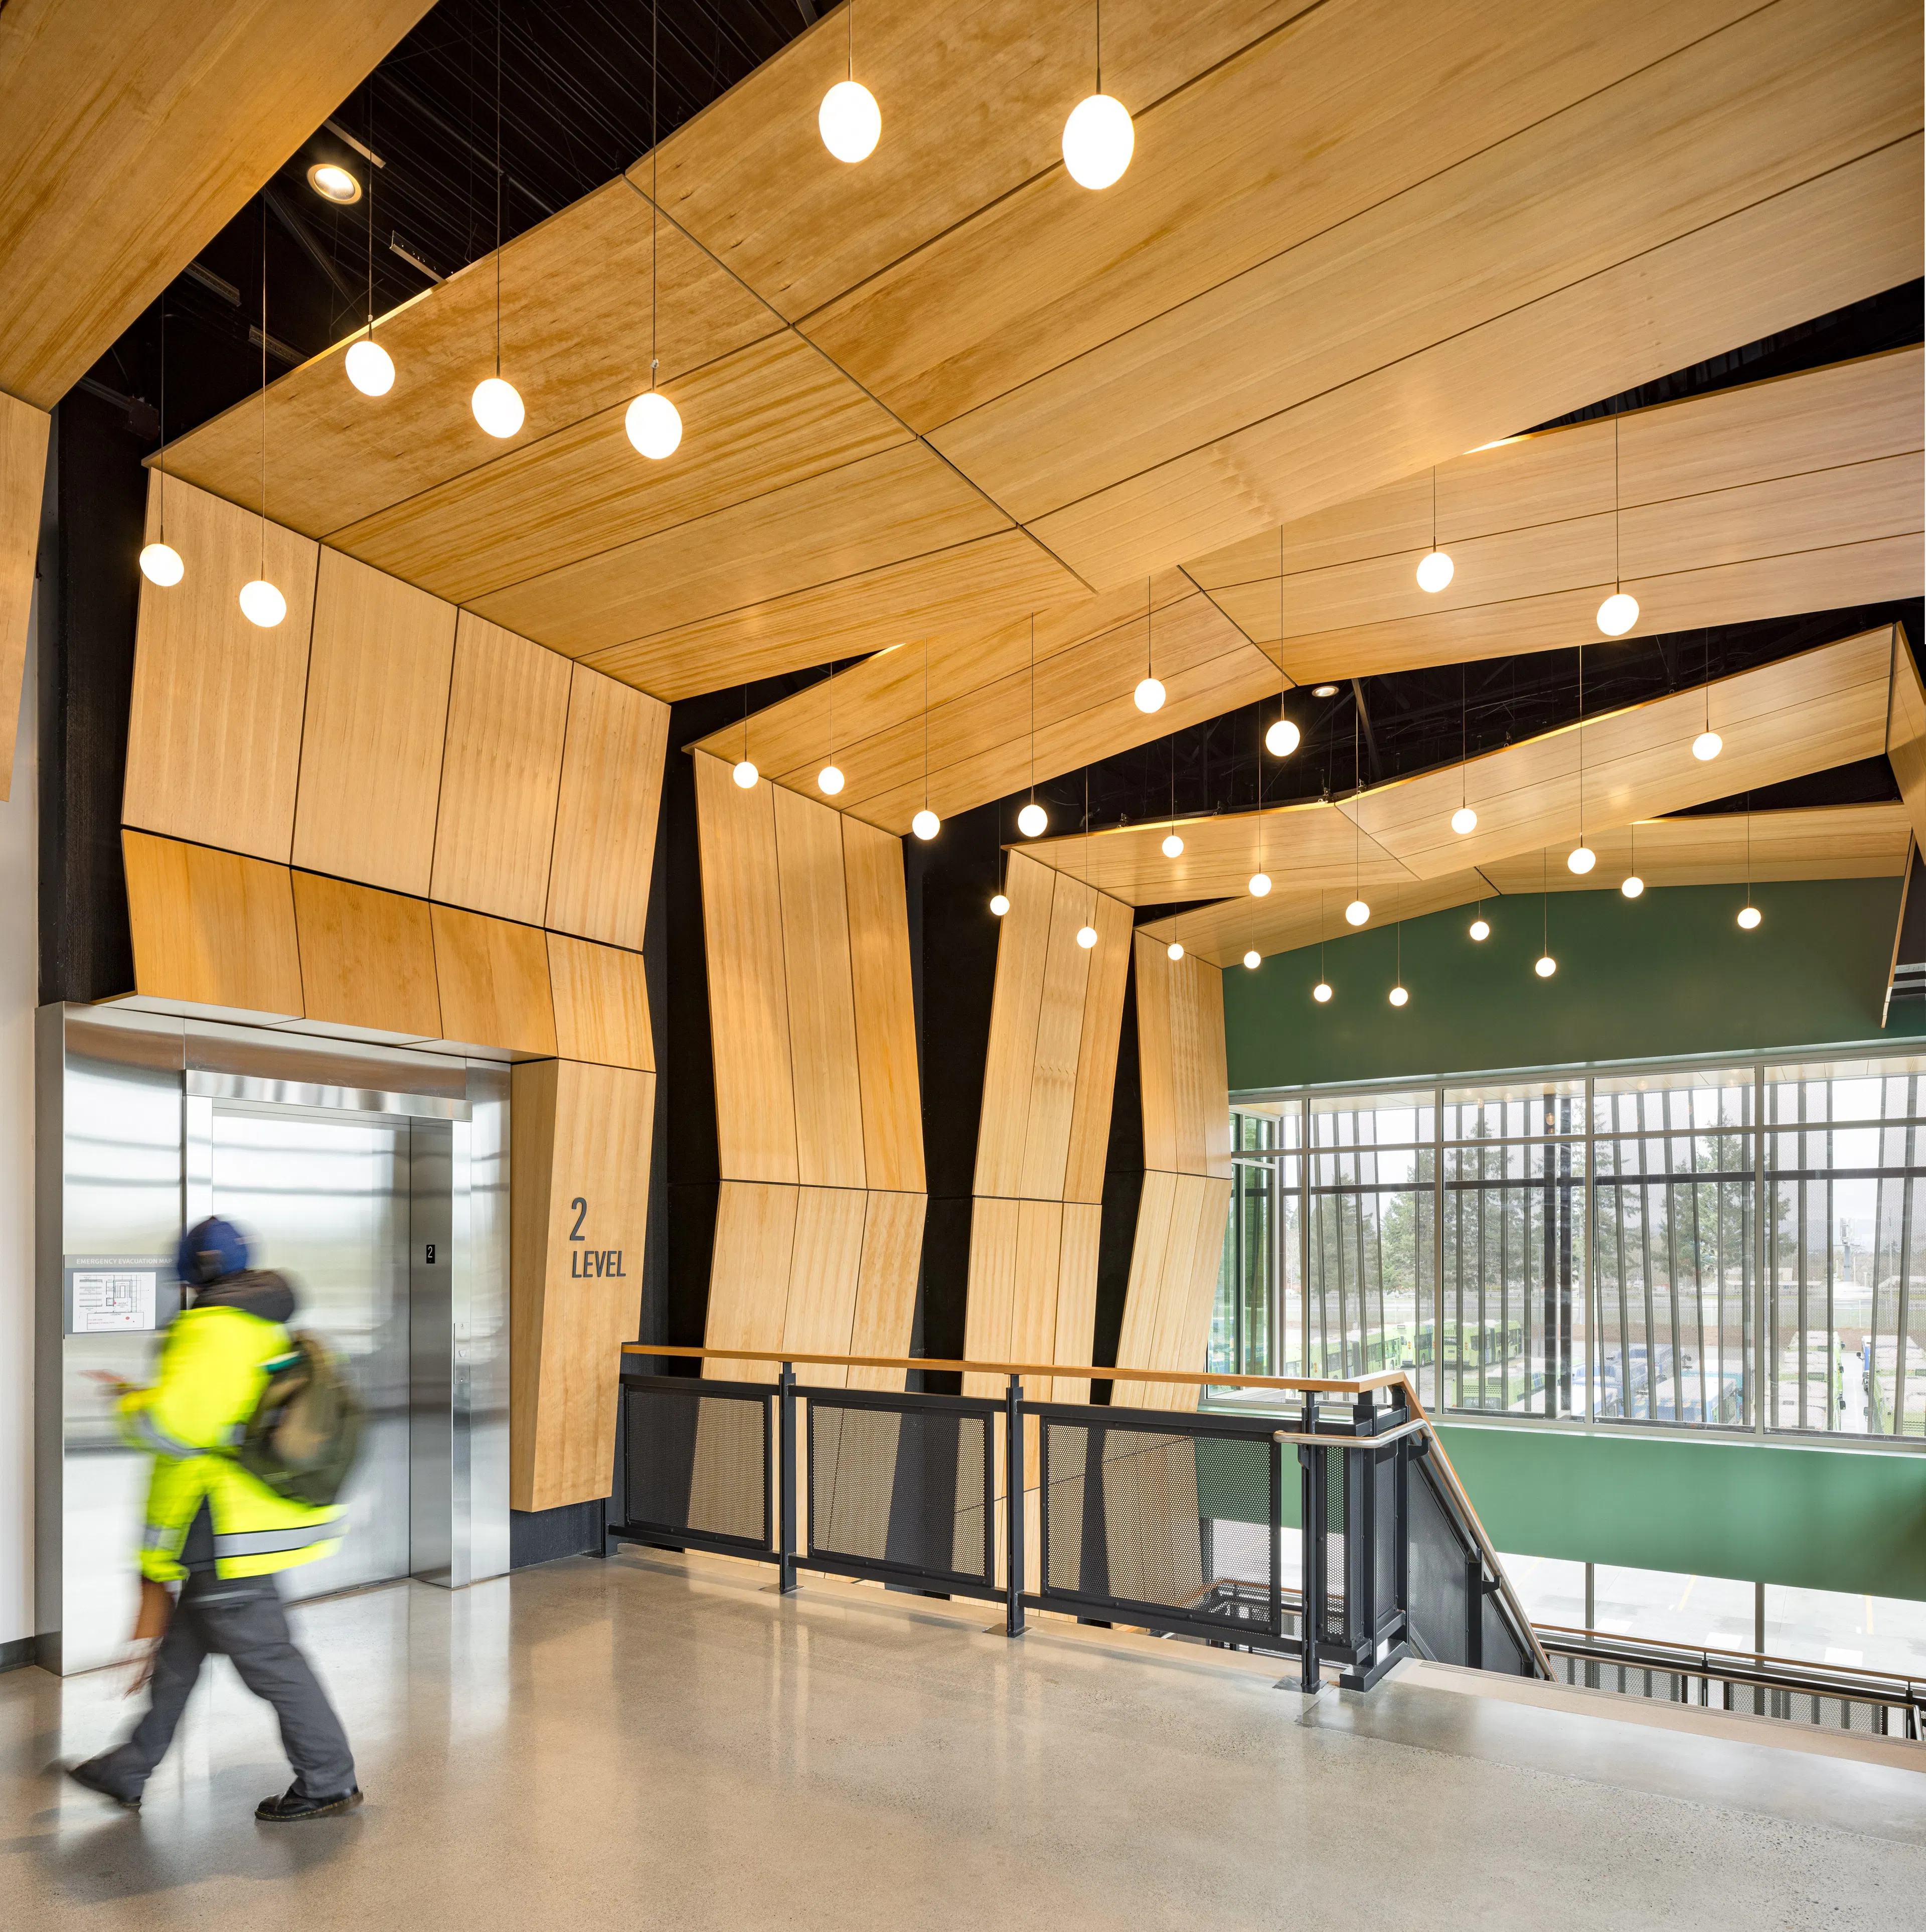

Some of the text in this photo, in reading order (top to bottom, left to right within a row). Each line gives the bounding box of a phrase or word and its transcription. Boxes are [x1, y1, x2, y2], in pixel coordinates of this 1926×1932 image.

[569, 1197, 587, 1241] 2
[427, 1246, 433, 1258] 2
[572, 1250, 626, 1278] LEVEL
